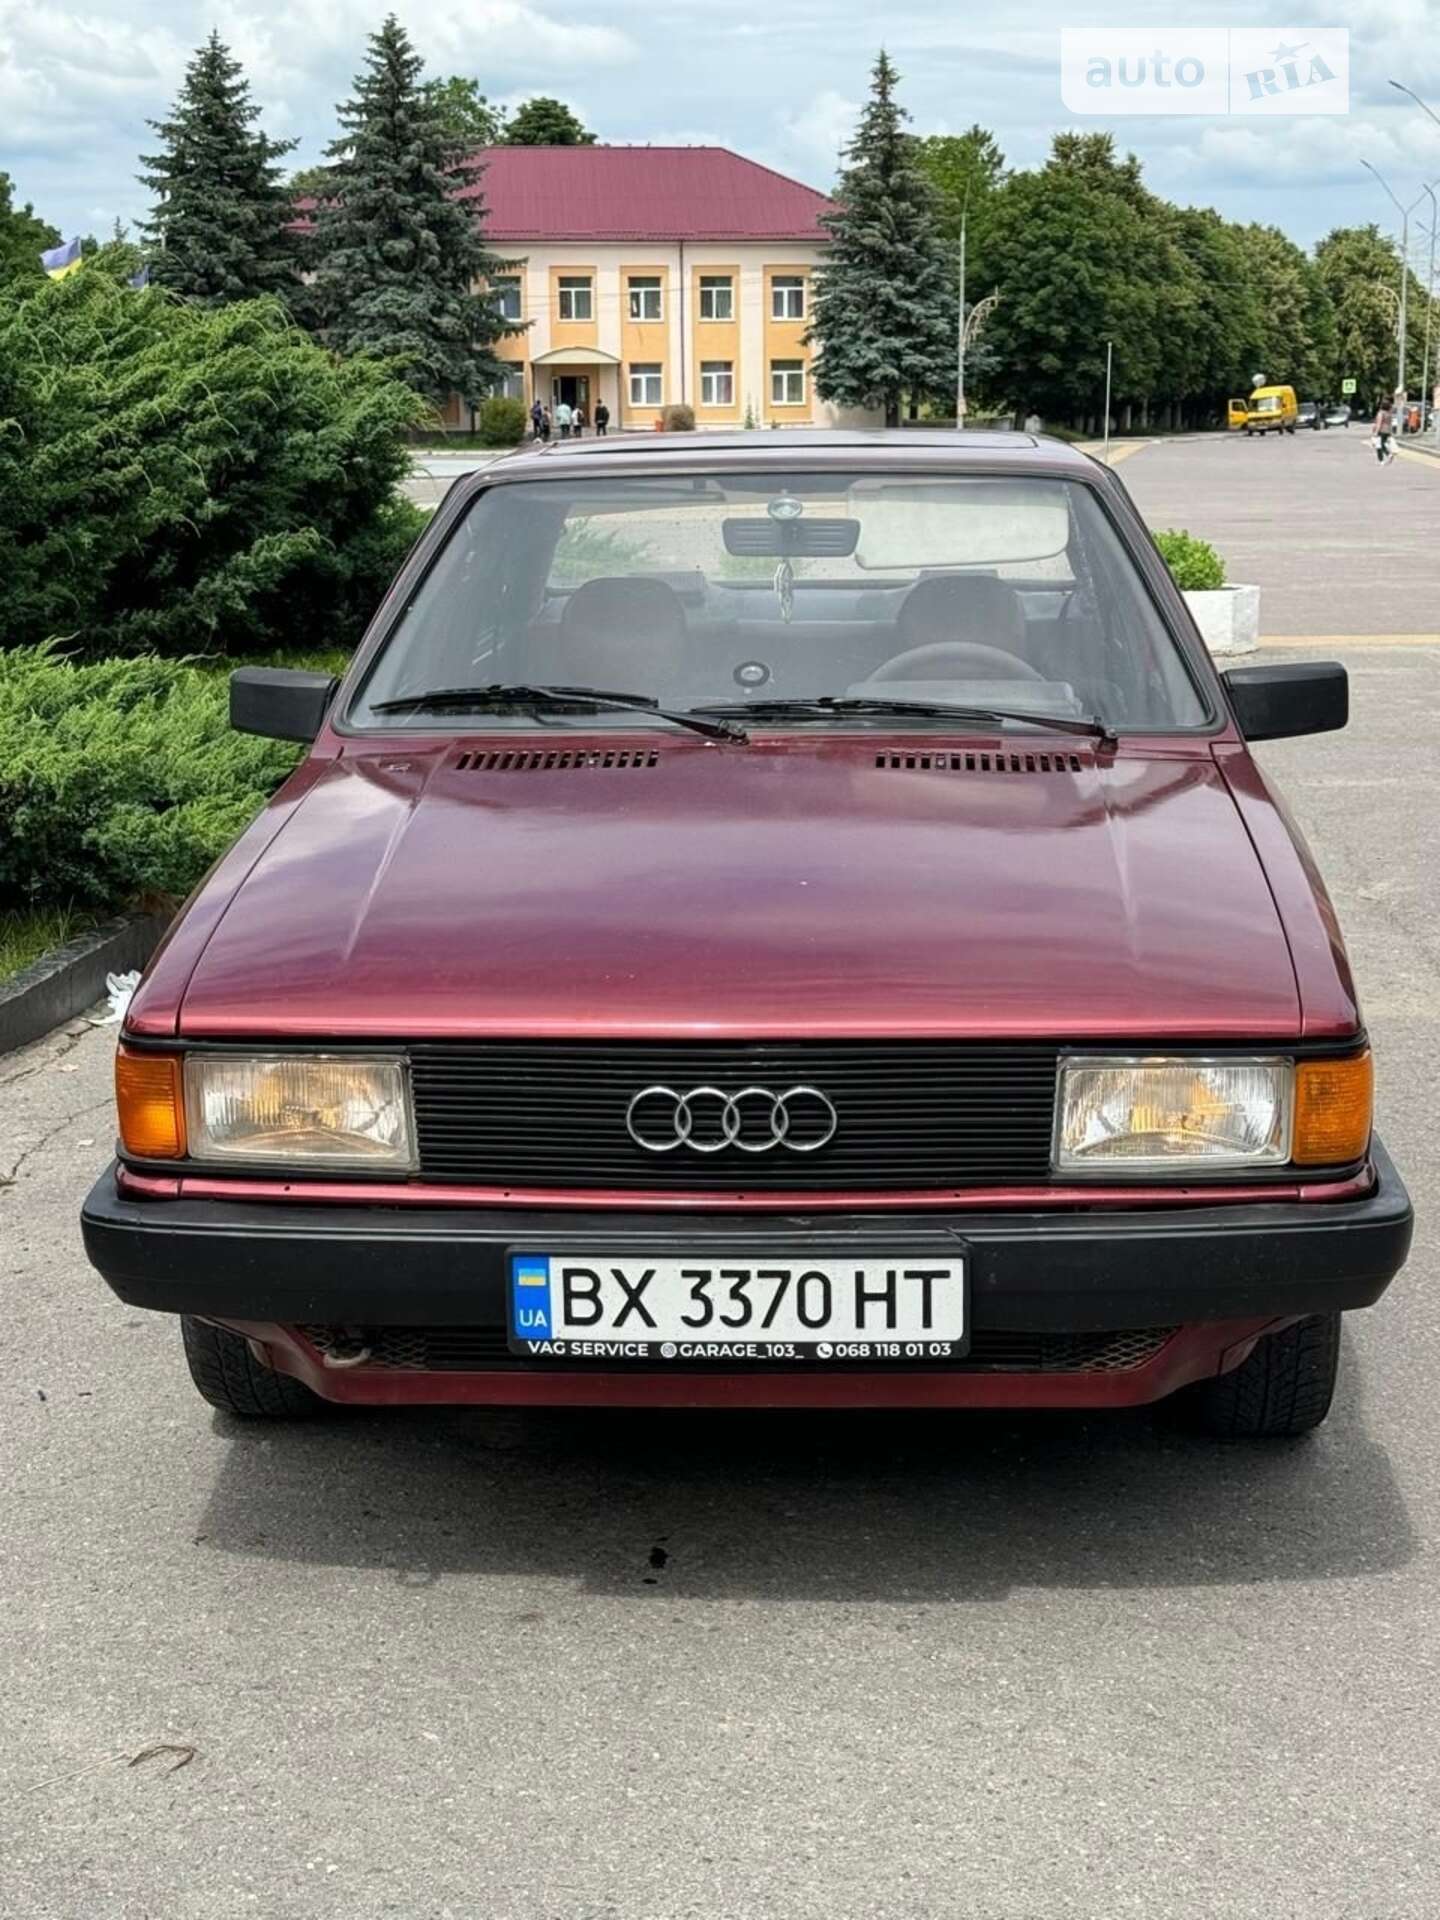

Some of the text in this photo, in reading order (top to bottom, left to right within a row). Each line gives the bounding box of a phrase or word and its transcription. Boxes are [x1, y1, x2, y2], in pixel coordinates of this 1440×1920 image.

[561, 1267, 951, 1329] BX 3370 HT
[519, 1309, 548, 1327] UA
[527, 1341, 566, 1356] VAG
[570, 1342, 649, 1357] SERVICE
[836, 1343, 871, 1357] 068
[874, 1343, 901, 1357] 118
[905, 1343, 925, 1357] 01
[929, 1343, 952, 1357] 03
